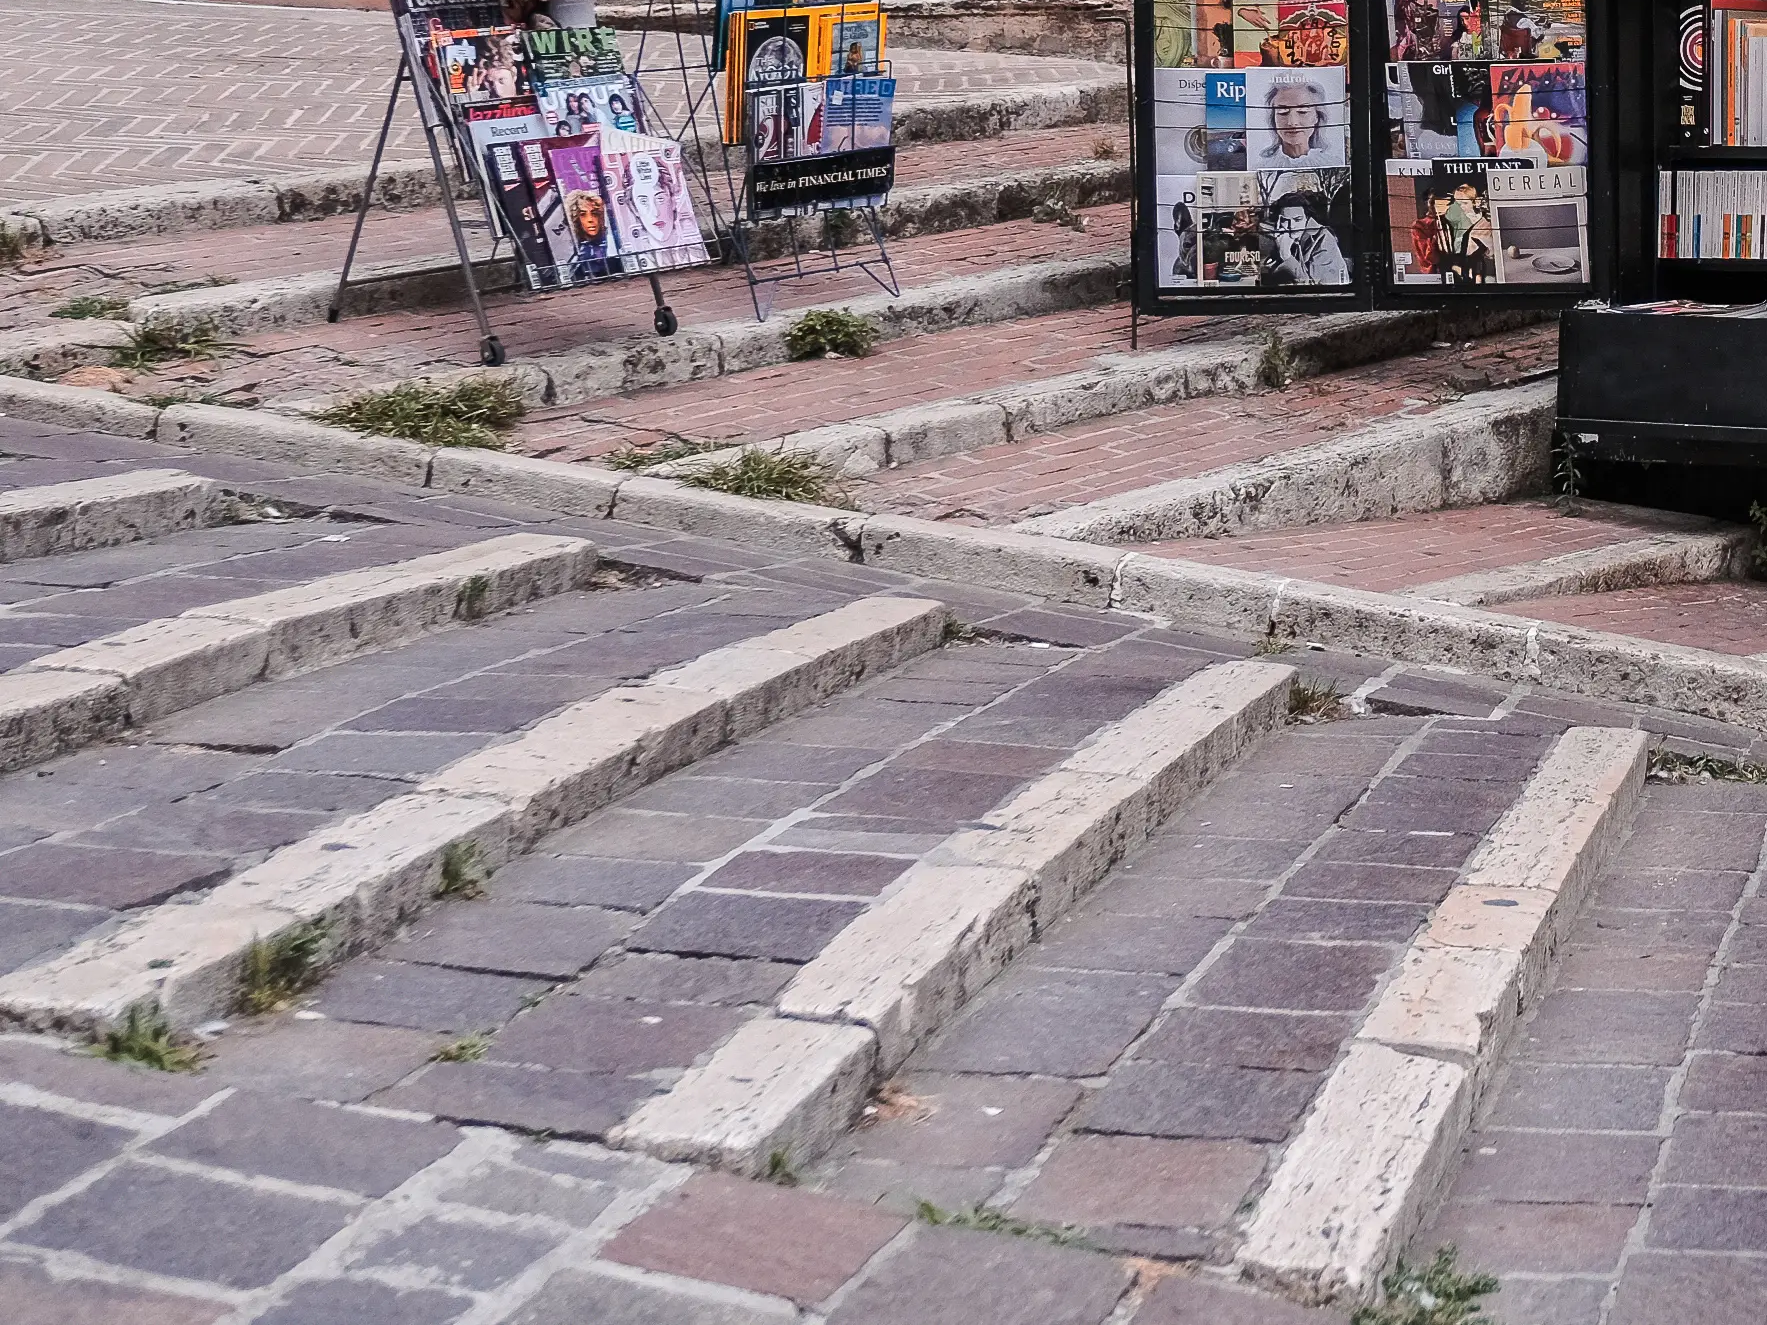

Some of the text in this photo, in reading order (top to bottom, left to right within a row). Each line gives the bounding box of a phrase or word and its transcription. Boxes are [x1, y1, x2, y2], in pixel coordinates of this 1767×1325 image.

[531, 26, 617, 55] WIRE
[491, 122, 528, 138] Record
[798, 171, 854, 188] FINANCIAL
[856, 166, 887, 180] TIMES
[1444, 163, 1474, 174] THE
[1492, 174, 1577, 192] CEREAL
